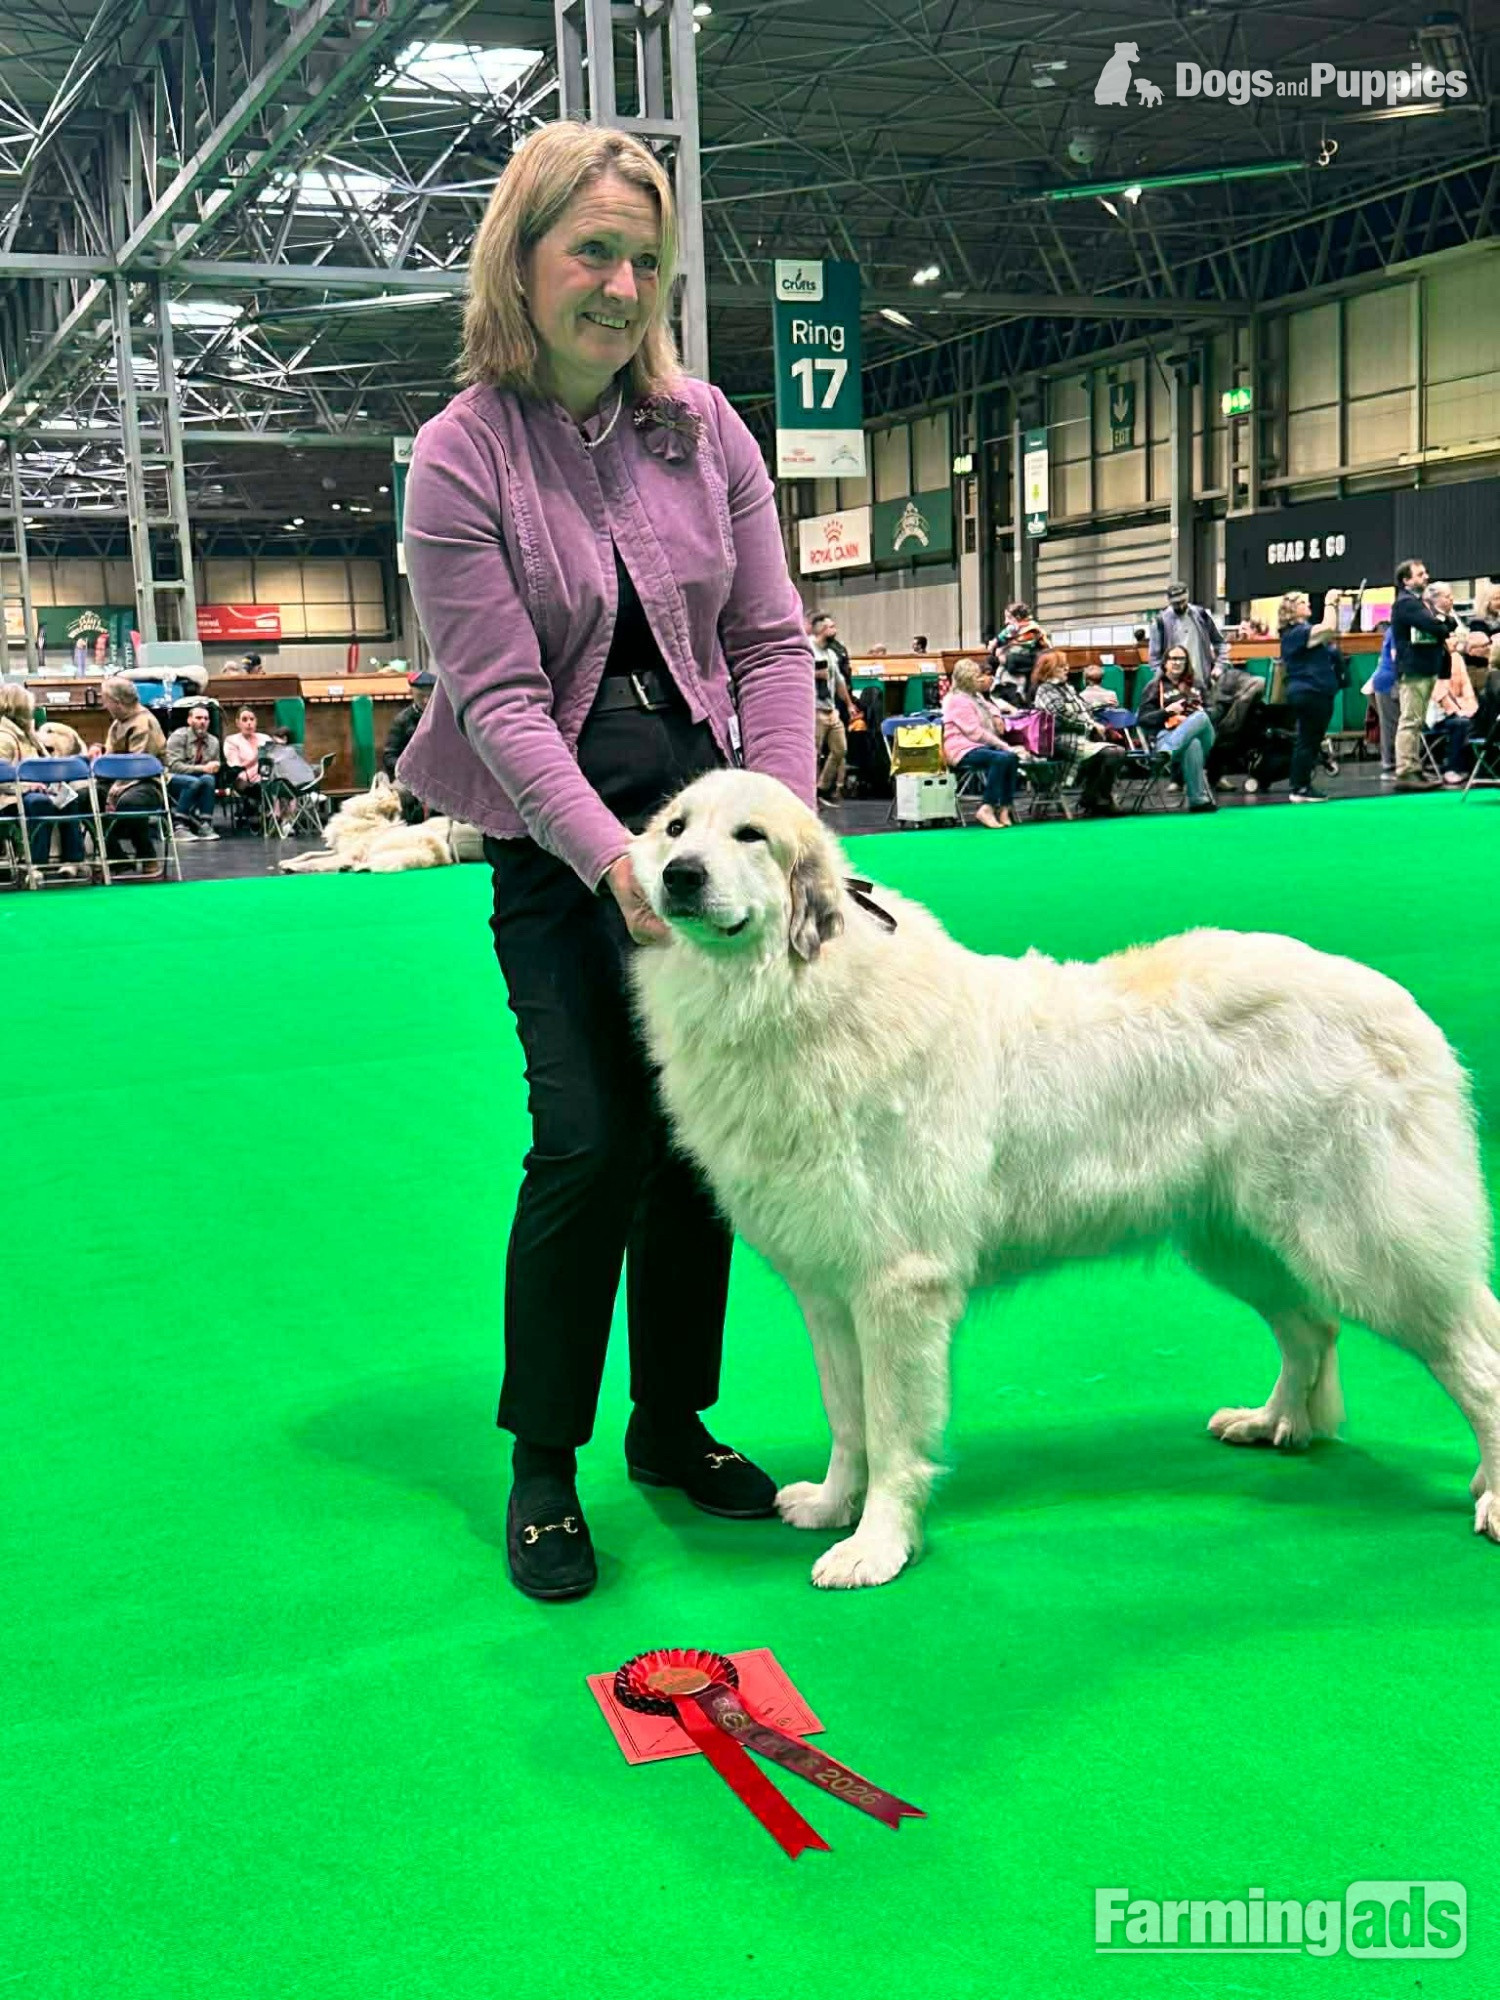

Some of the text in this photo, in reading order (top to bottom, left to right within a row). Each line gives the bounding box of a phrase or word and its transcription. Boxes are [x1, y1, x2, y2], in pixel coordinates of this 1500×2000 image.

[782, 279, 816, 291] Crufts
[792, 319, 845, 352] Ring
[791, 358, 848, 408] 17
[1267, 534, 1346, 565] GRAB & GO
[814, 1768, 883, 1806] 2026
